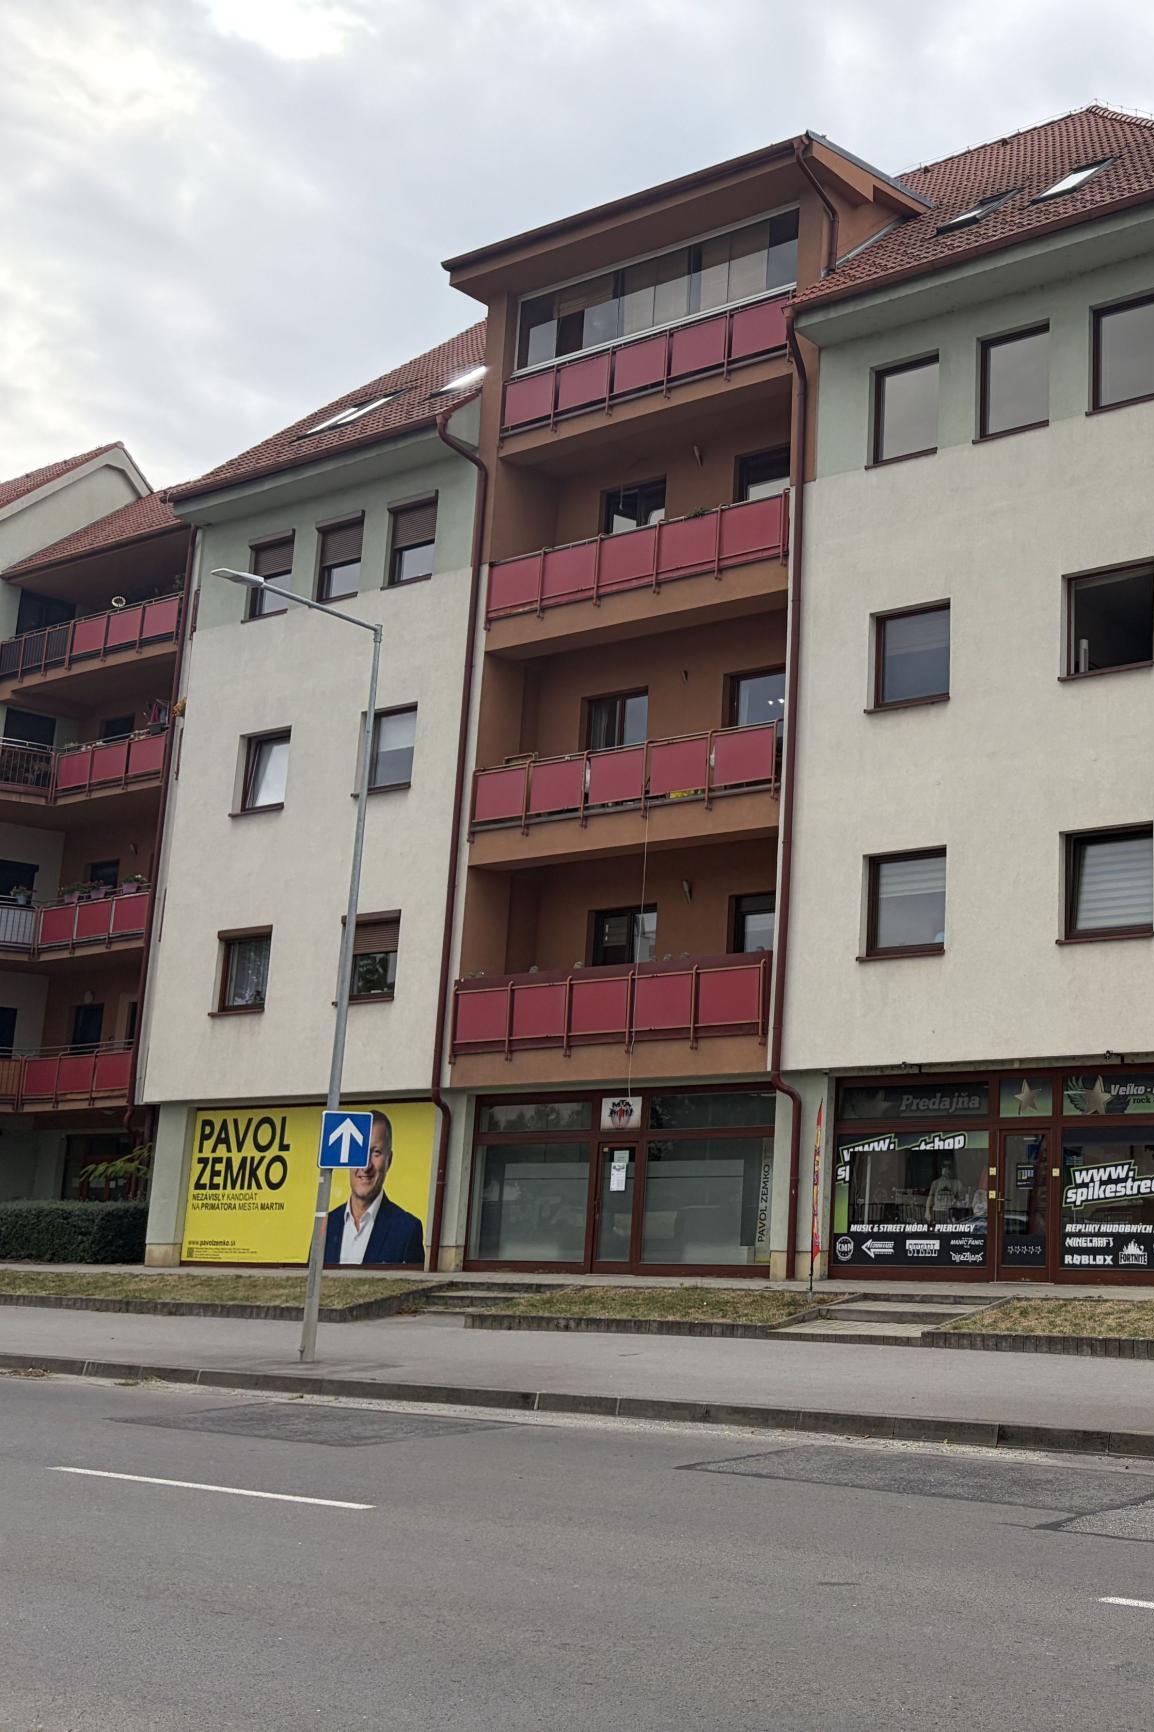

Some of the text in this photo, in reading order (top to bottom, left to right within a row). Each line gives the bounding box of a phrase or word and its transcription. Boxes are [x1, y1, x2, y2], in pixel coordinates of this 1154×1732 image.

[900, 1093, 980, 1112] Predajňa
[1132, 1095, 1151, 1104] rock
[198, 1116, 291, 1154] PAVOL
[193, 1154, 289, 1192] ZEMKO
[1074, 1164, 1134, 1184] www.
[238, 1202, 259, 1211] MESTA
[260, 1202, 285, 1211] MARTIN
[757, 1164, 771, 1243] PAVOL ZEMKO
[850, 1222, 976, 1233] MUSIC & STREET MÓDA PIERCINGY
[1065, 1224, 1101, 1233] REPLIKY
[1101, 1223, 1153, 1234] HUDOBNÝCH
[1065, 1237, 1114, 1248] MINECRAFT
[907, 1243, 938, 1257] STEEL
[1064, 1254, 1114, 1265] ROBLOX
[1119, 1252, 1147, 1264] FORTNITE
